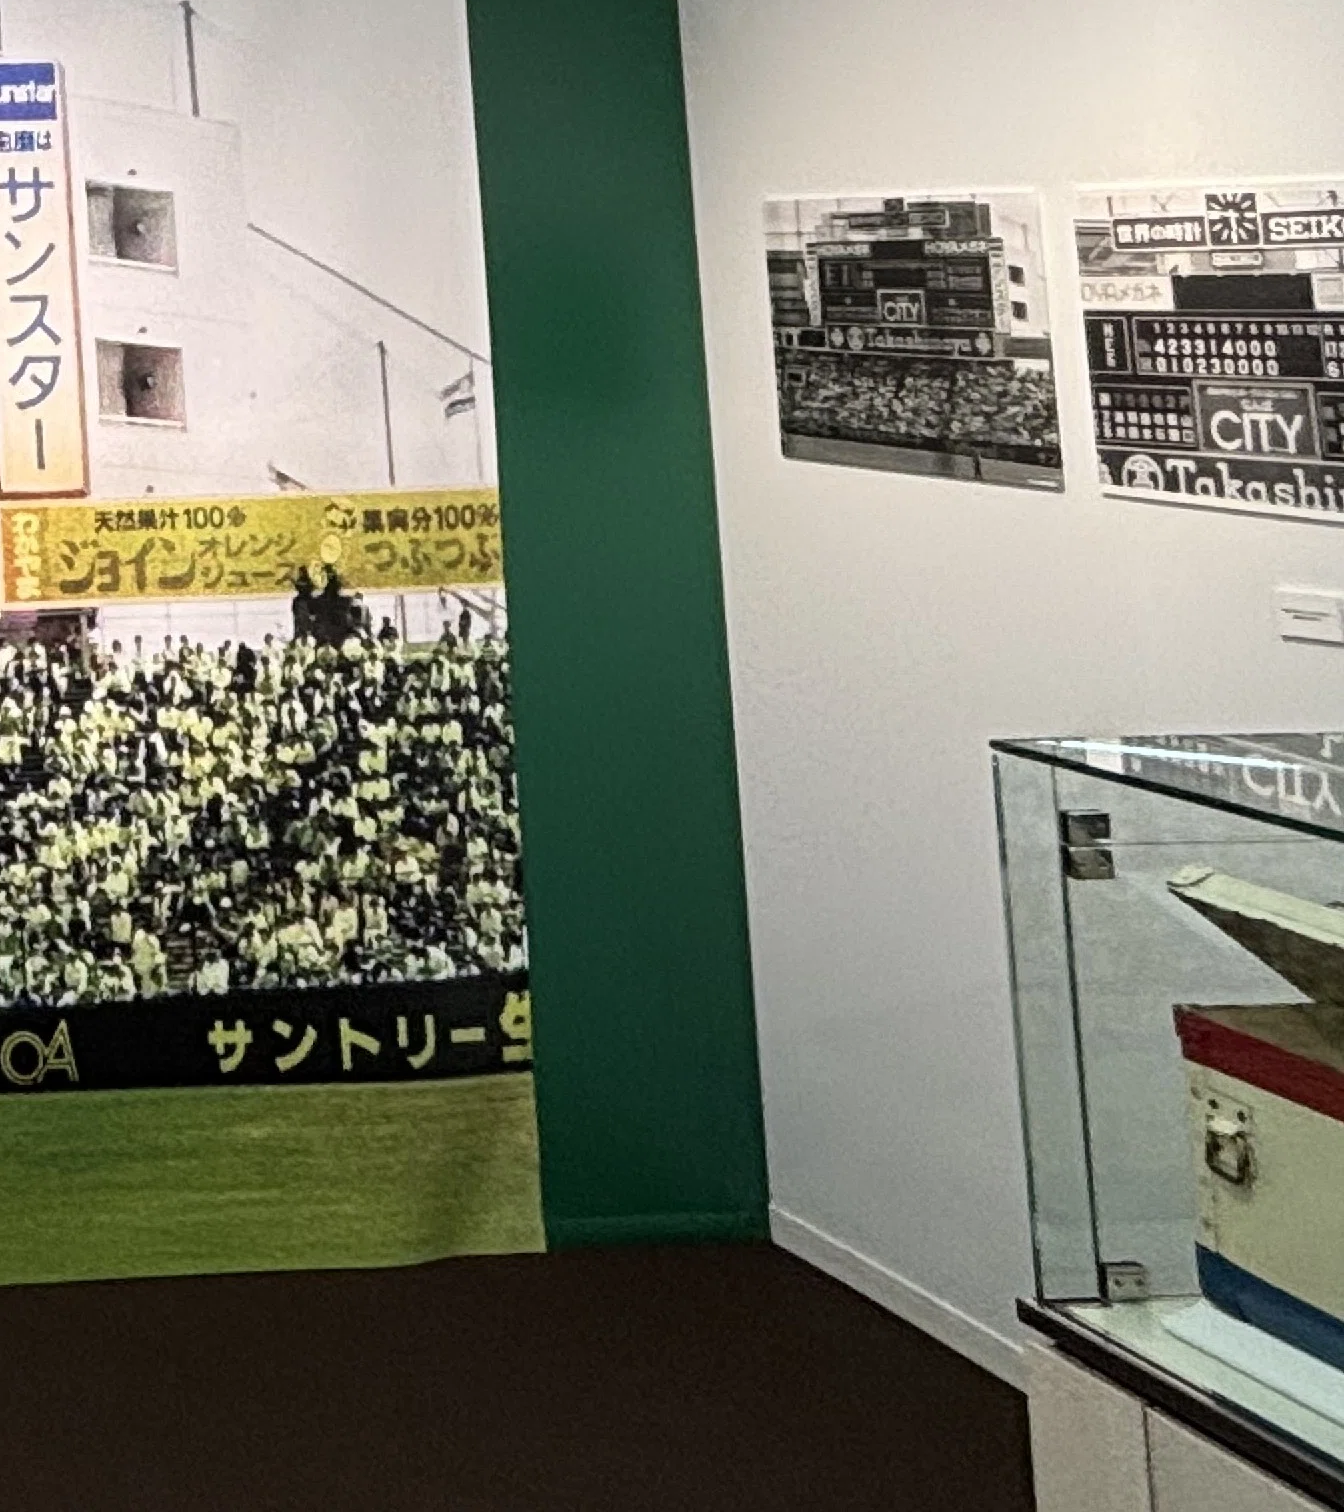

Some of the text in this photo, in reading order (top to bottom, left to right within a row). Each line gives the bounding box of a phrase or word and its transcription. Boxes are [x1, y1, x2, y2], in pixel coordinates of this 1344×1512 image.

[1211, 410, 1303, 454] CITY
[58, 535, 196, 594] ジョイン
